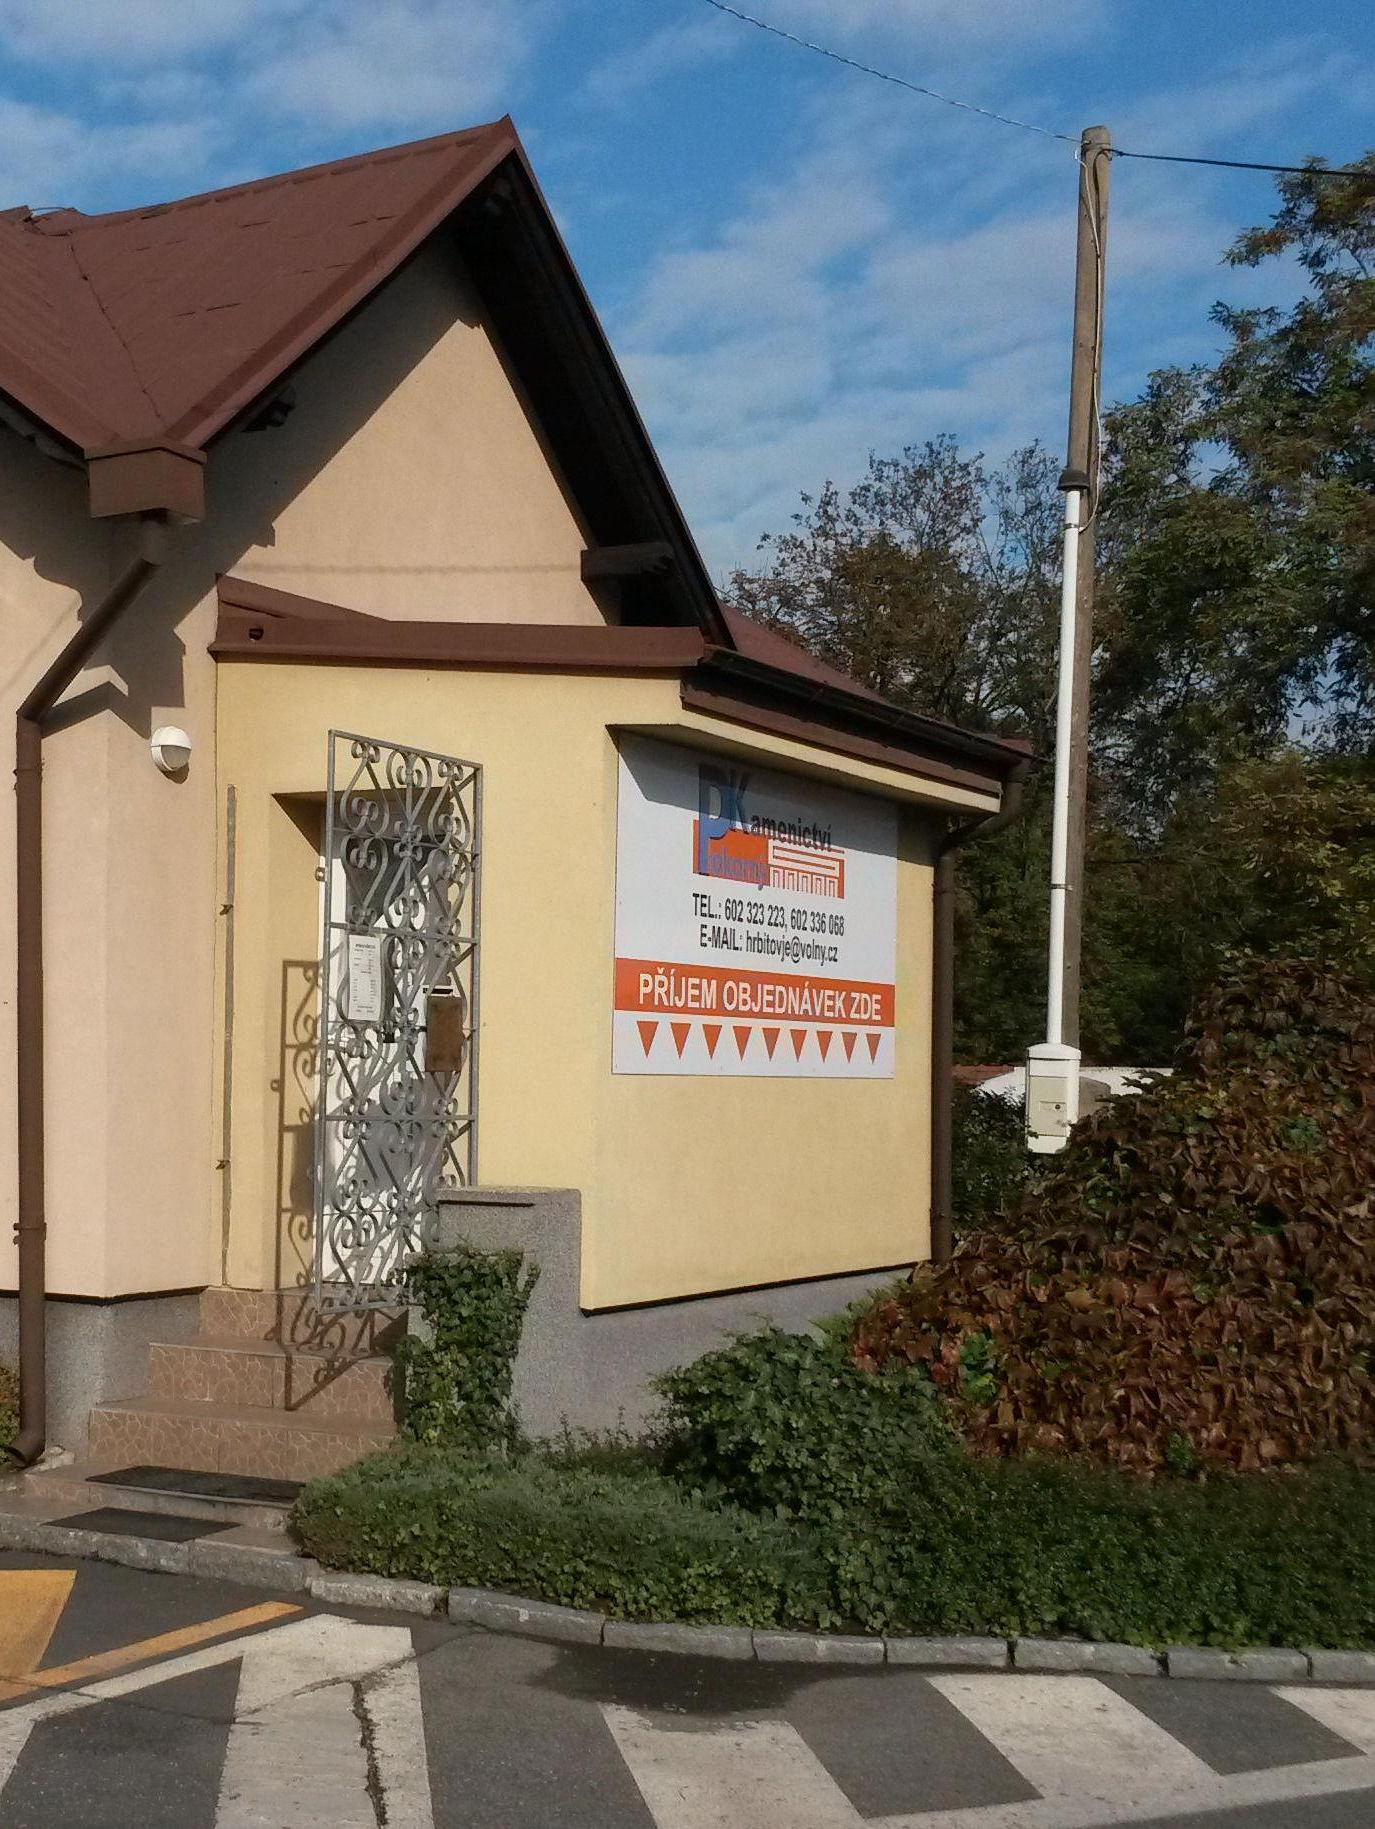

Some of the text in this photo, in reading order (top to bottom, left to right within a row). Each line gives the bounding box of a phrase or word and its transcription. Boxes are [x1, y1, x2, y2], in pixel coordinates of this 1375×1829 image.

[729, 769, 832, 851] Kamenictví
[692, 892, 845, 936] TEL.: 602 323 223, 602 336 068
[700, 924, 838, 966] E-MAIL: hrbitovje@volny.cz
[639, 967, 882, 1021] PŘÍJEM OBJEDNÁVEK ZDE
